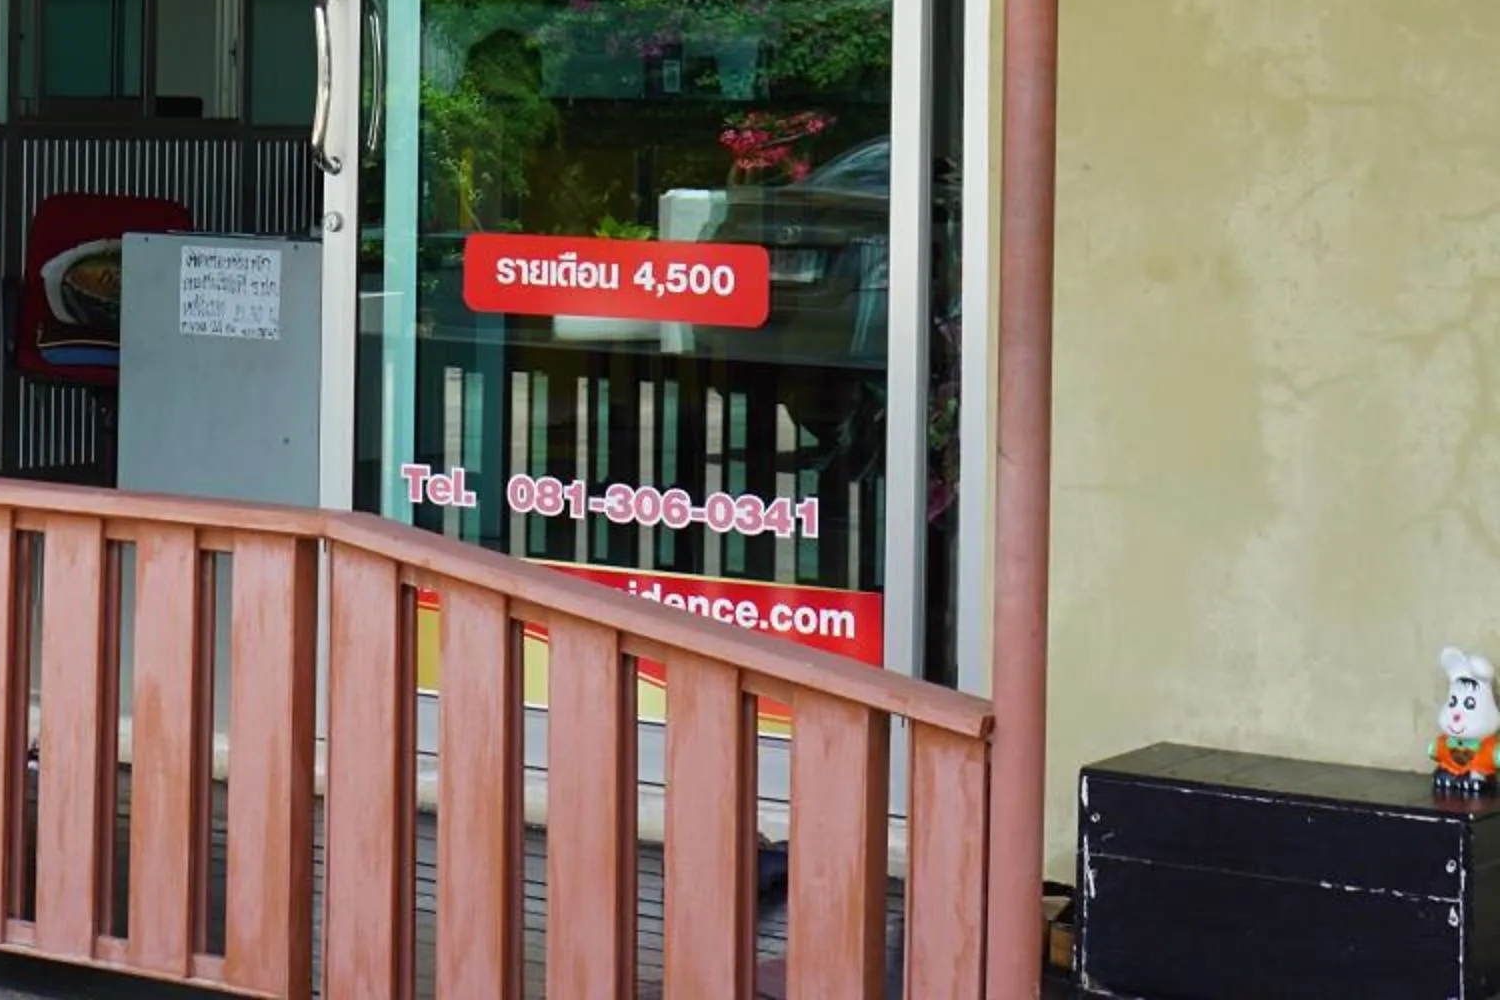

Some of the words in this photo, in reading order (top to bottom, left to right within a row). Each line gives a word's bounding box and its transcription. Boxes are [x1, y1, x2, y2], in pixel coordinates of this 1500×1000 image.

[495, 251, 620, 290] รายเดือน
[632, 261, 736, 297] 4,500
[402, 464, 477, 508] Tel.
[507, 475, 820, 539] 081-306-0341
